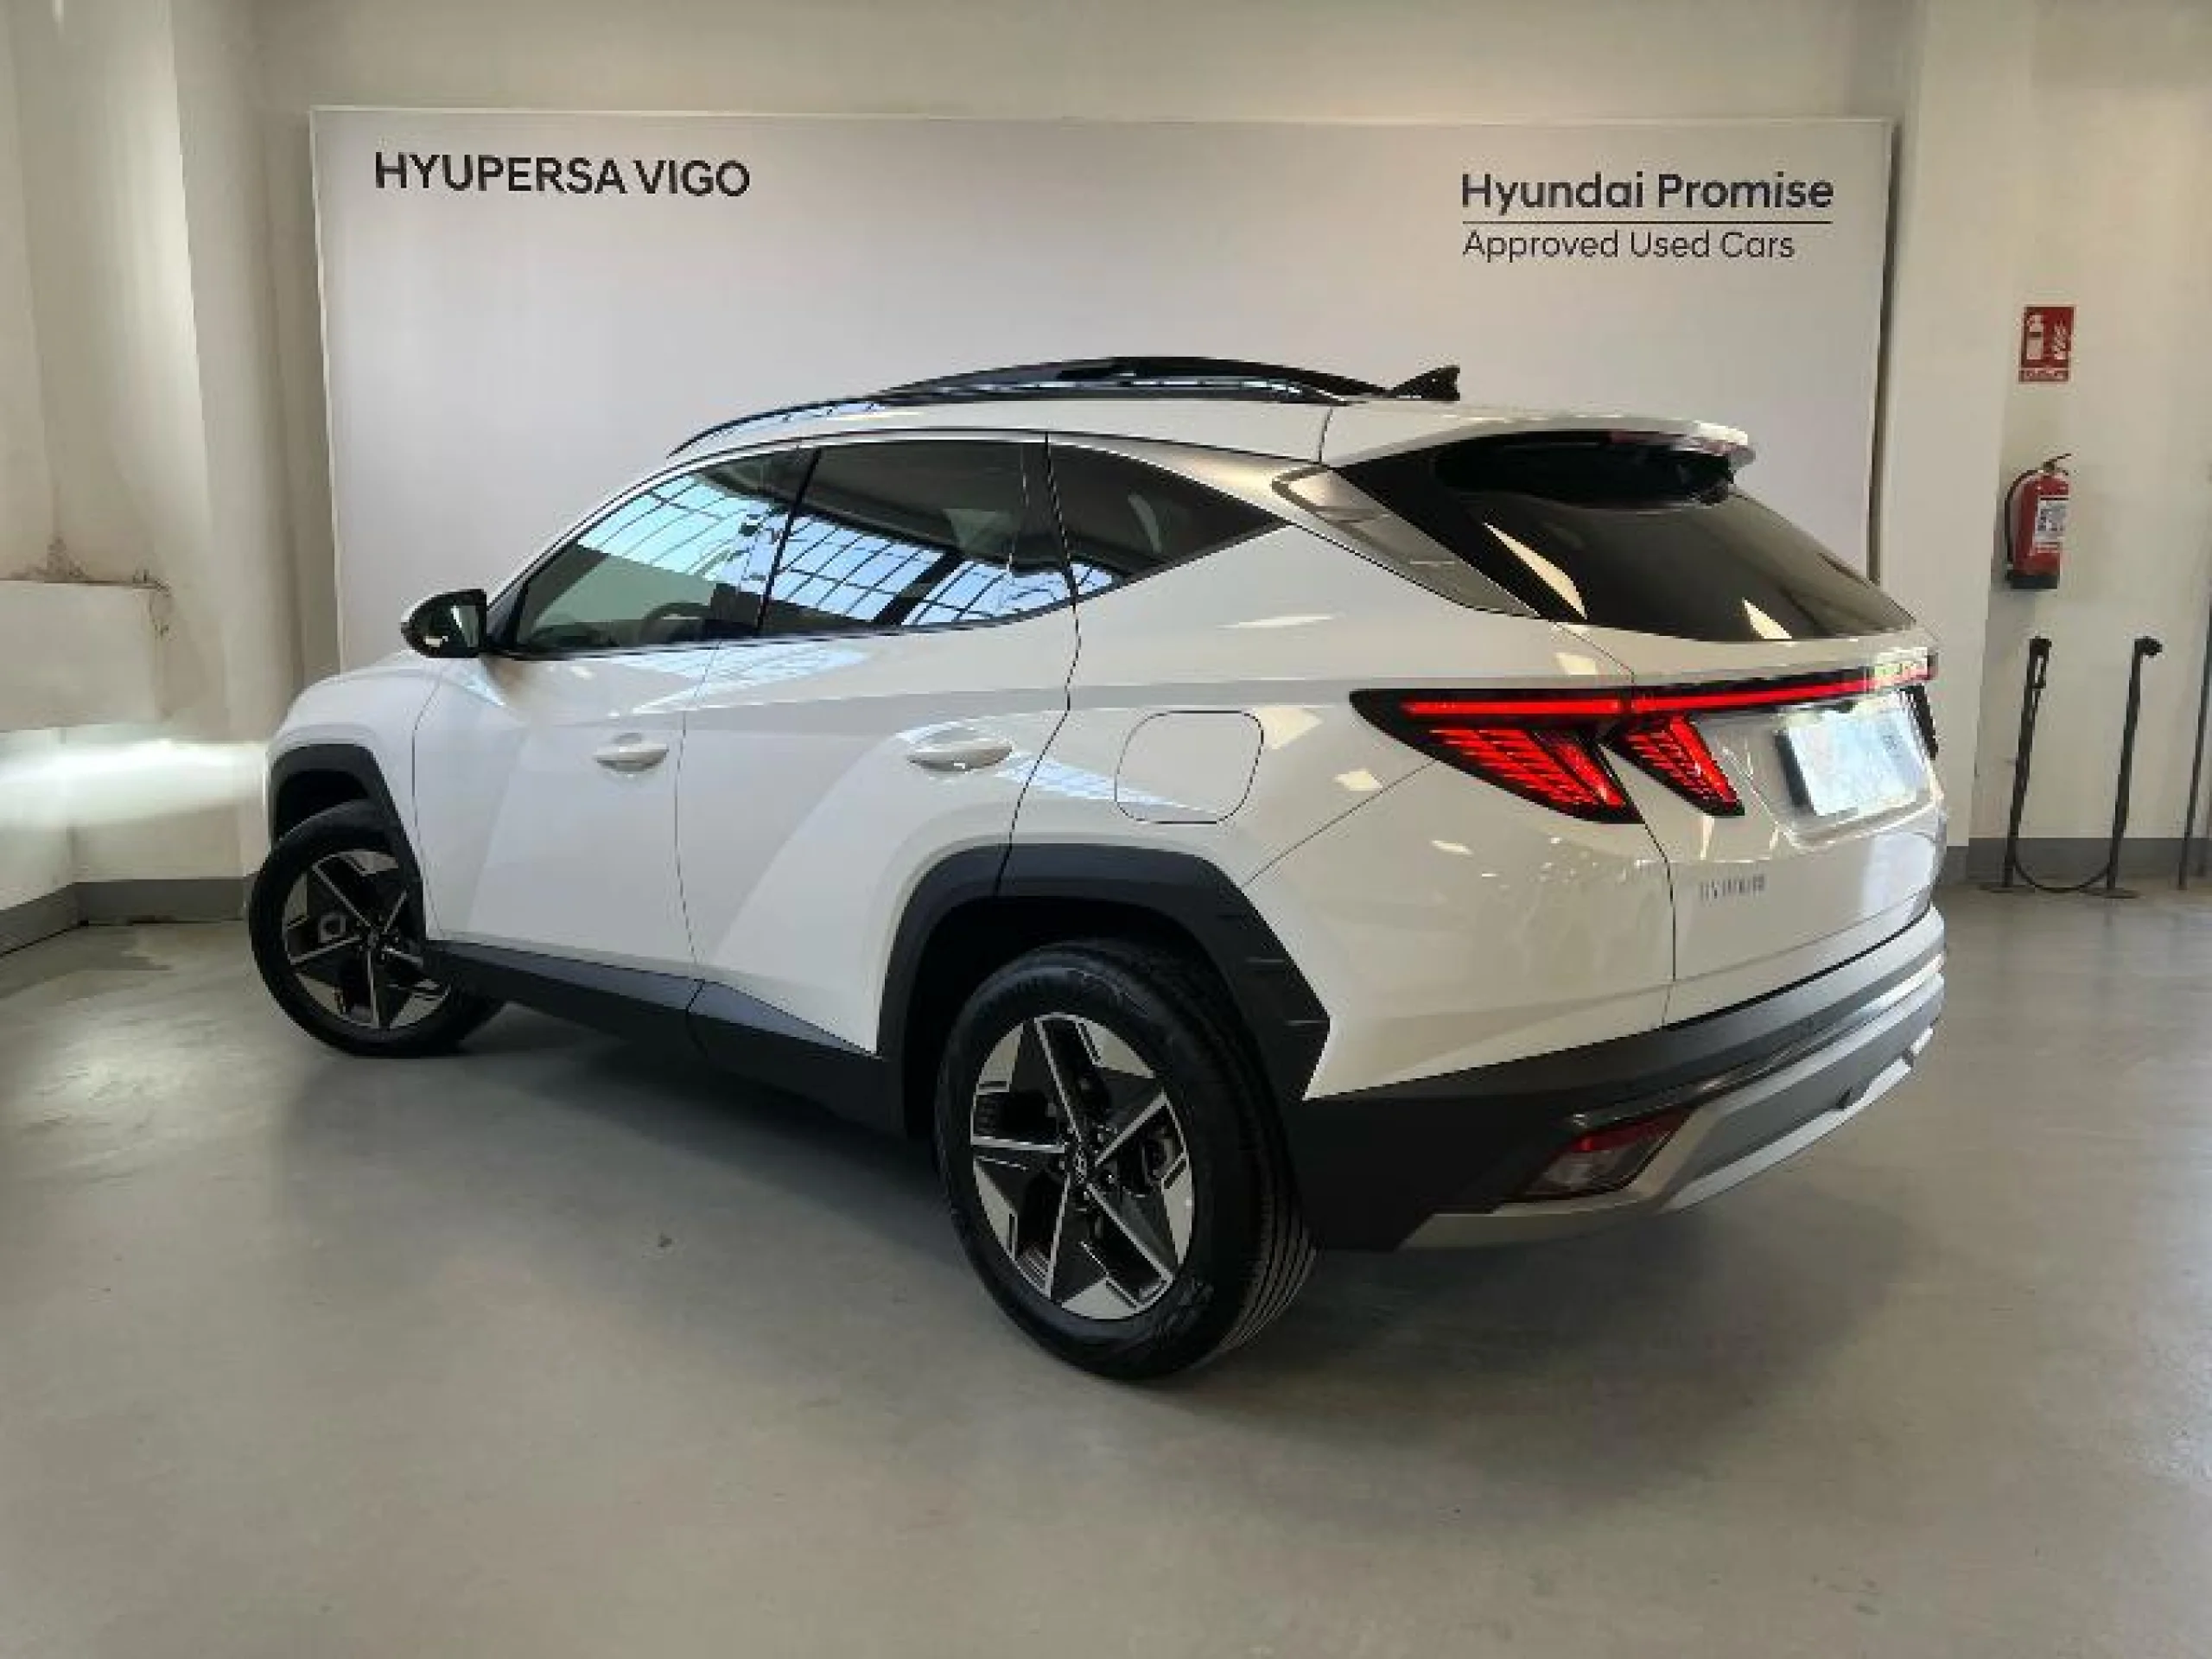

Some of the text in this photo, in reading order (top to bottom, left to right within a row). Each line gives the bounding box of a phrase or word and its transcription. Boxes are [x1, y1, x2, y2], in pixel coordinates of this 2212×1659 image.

[375, 151, 750, 196] HYUPERSA VIGO
[1462, 170, 1834, 216] Hyundai Promise
[1463, 228, 1796, 264] Approved Used Cars
